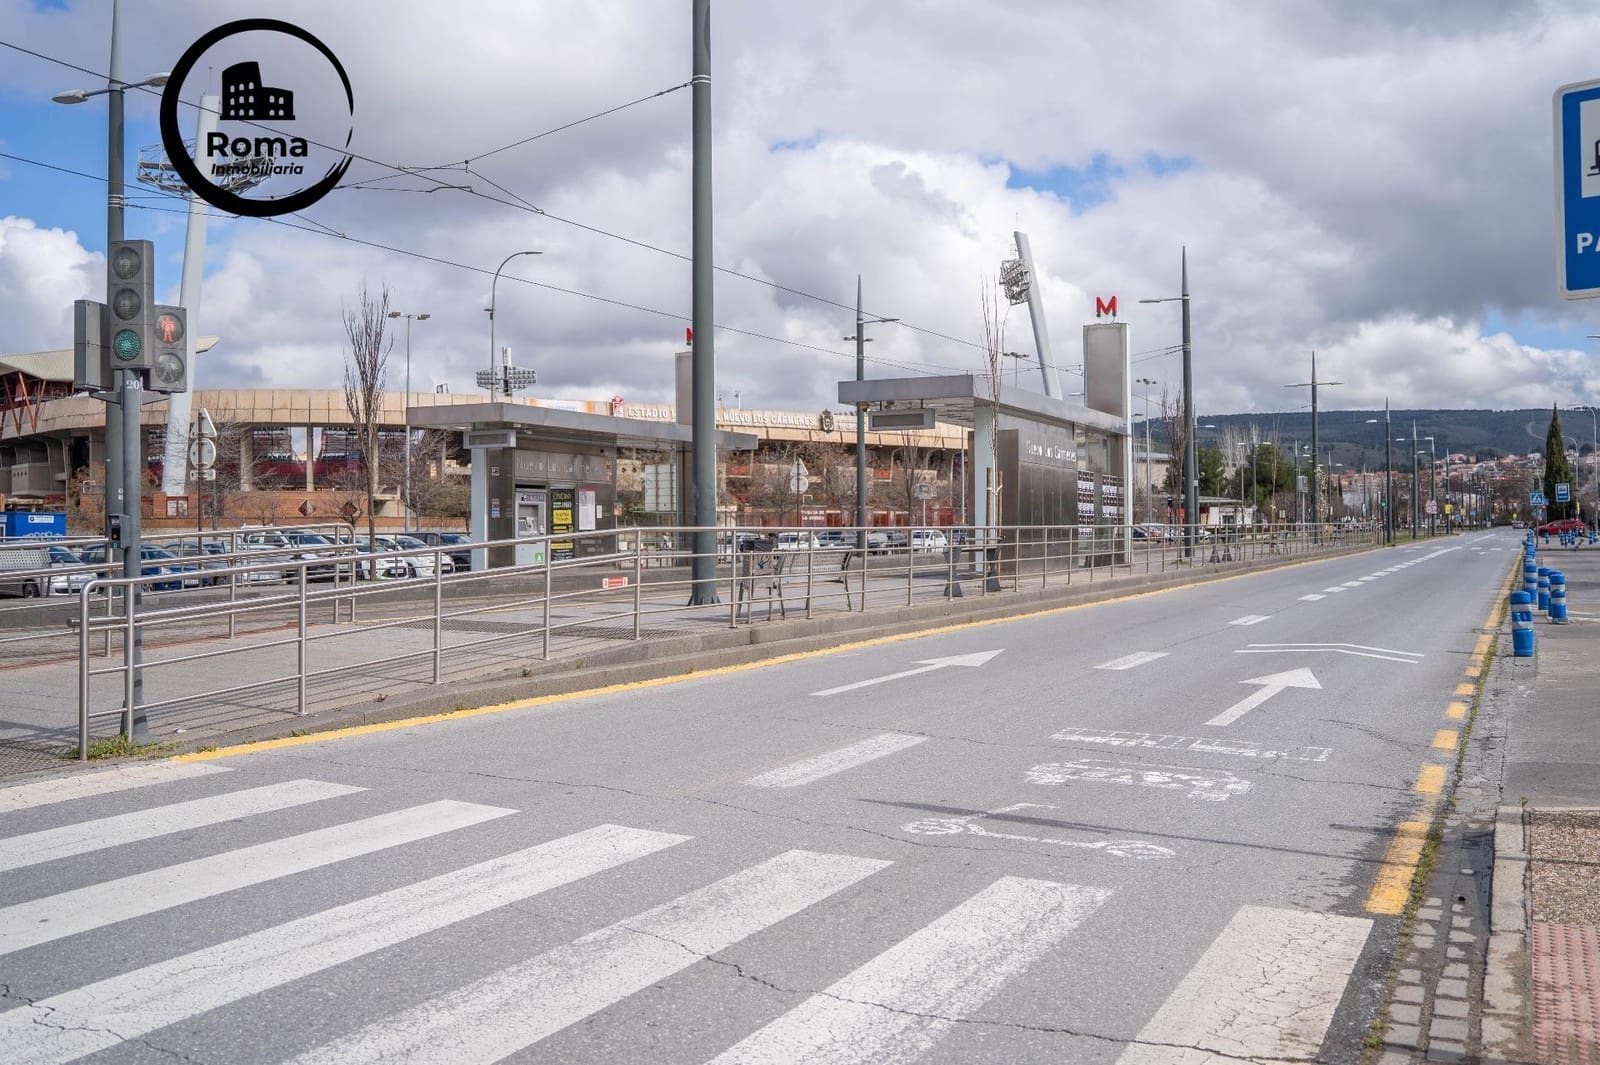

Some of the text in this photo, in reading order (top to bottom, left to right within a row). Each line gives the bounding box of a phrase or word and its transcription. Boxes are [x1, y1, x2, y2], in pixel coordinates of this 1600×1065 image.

[1577, 232, 1600, 255] P
[1097, 296, 1117, 315] M
[628, 408, 669, 419] ESTADIO
[723, 411, 751, 424] NUEVO
[753, 413, 769, 424] LOS
